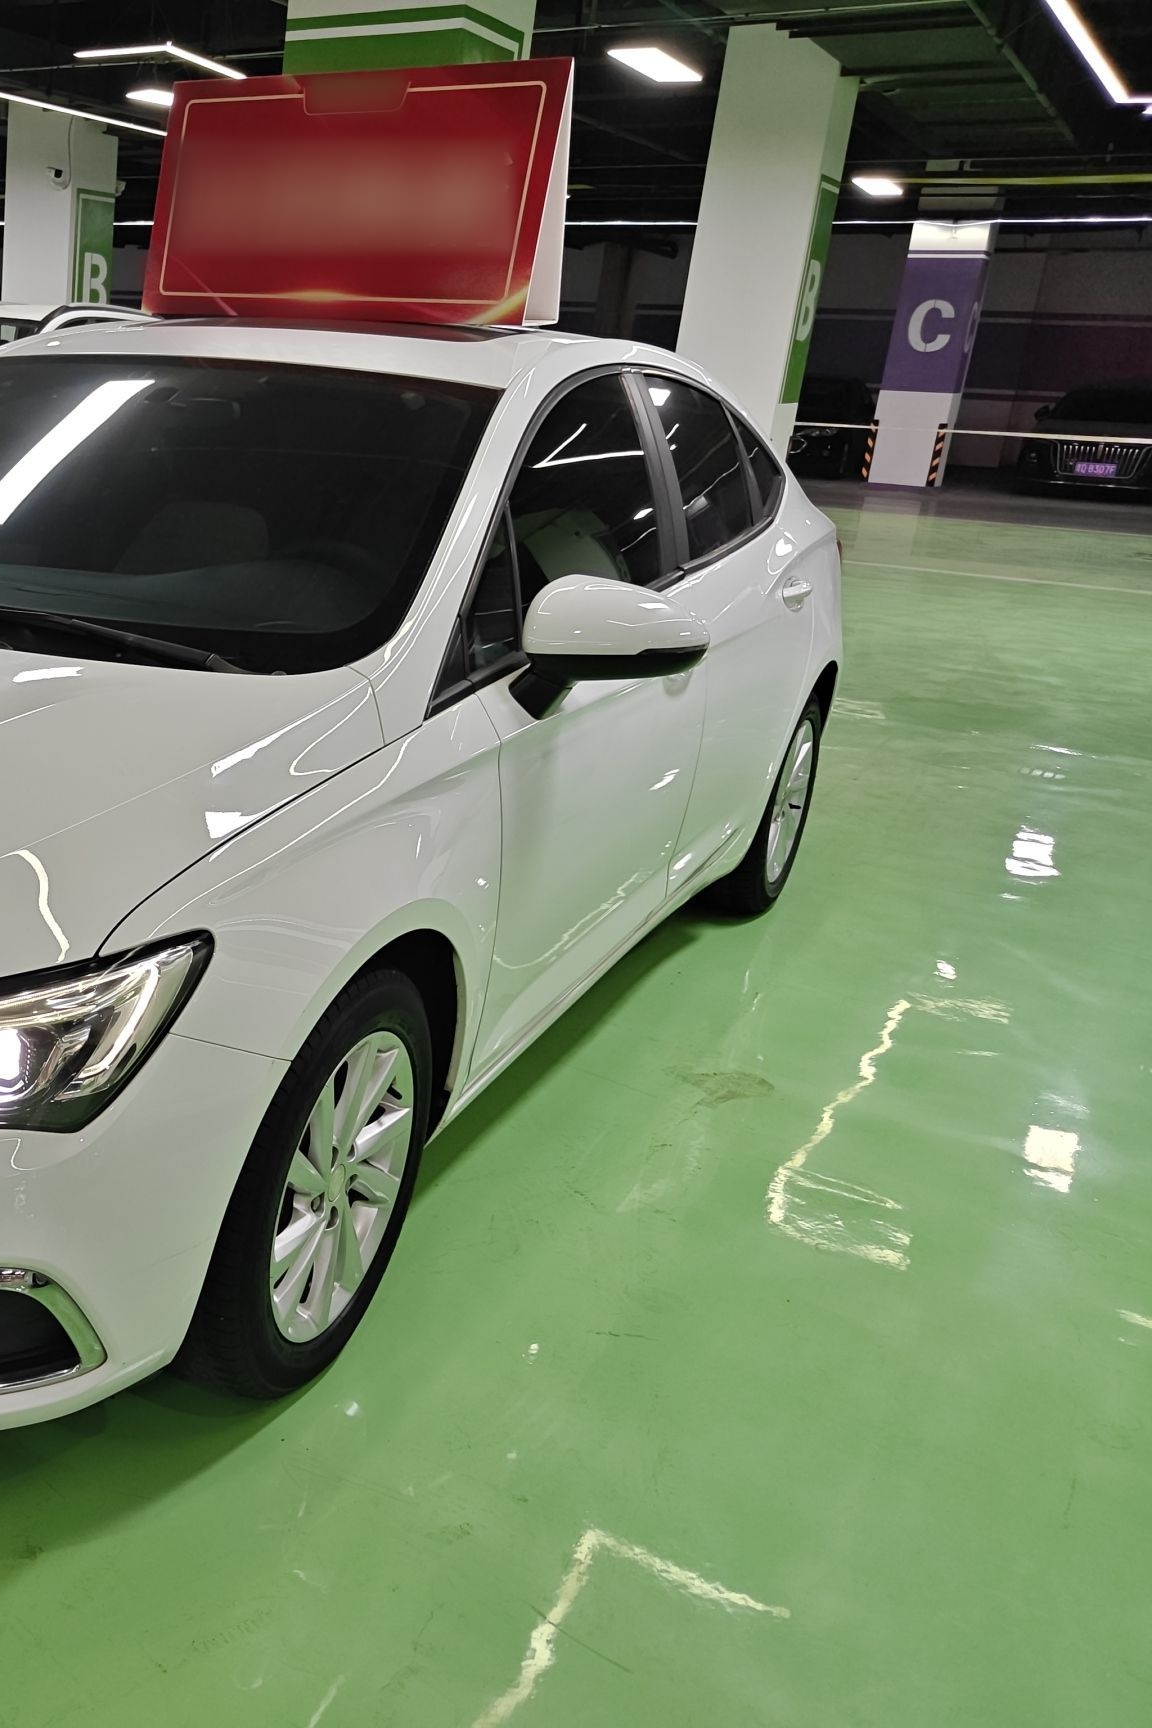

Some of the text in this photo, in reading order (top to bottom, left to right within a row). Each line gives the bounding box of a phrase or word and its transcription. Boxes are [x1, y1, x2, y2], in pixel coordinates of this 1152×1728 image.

[82, 252, 108, 304] B
[796, 259, 821, 341] B
[908, 299, 955, 352] C
